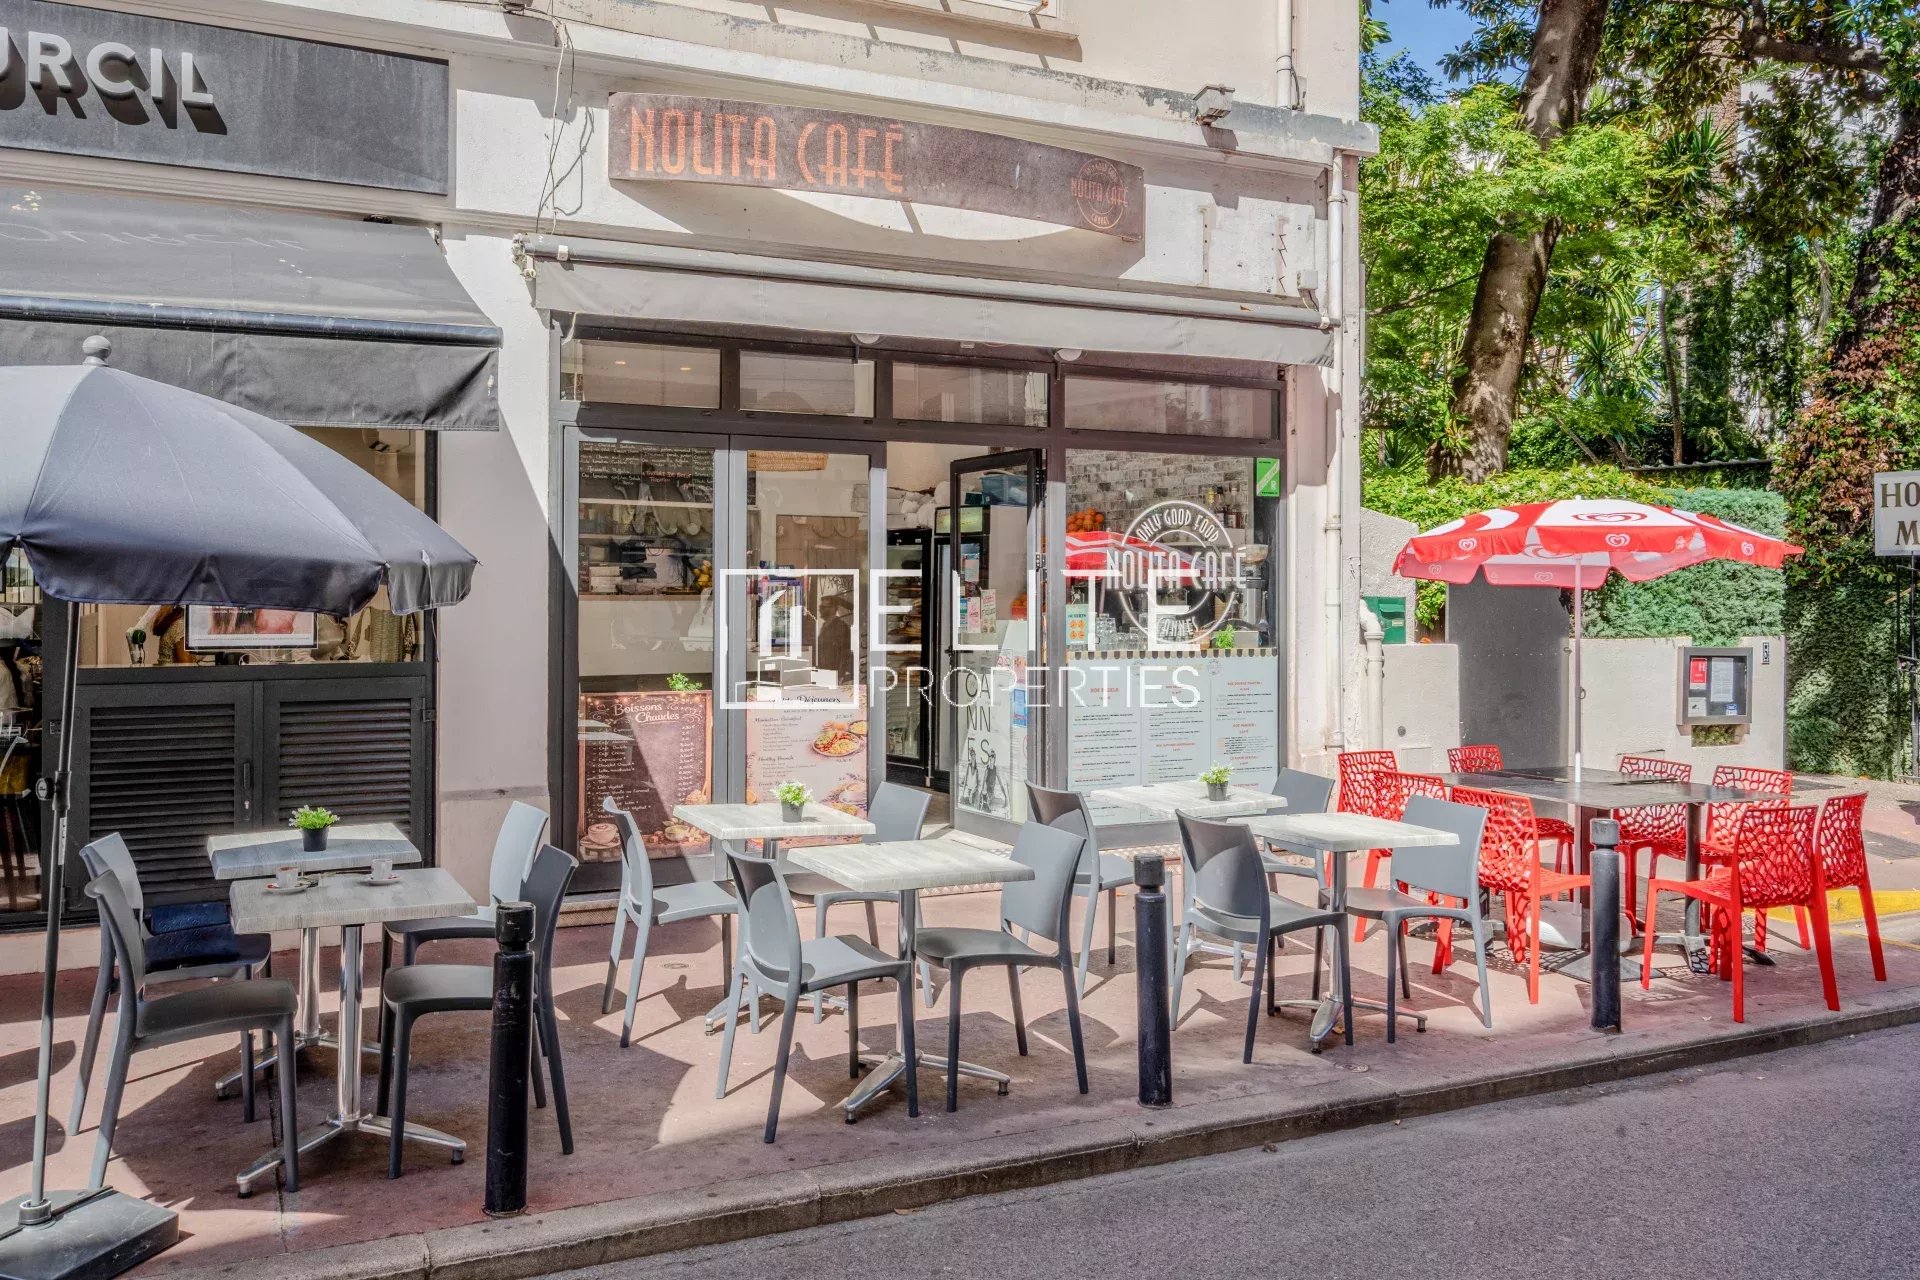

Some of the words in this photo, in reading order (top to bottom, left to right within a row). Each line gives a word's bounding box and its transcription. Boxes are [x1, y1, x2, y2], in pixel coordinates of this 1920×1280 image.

[0, 27, 213, 104] RCIL
[630, 106, 777, 181] NOLITA
[797, 122, 904, 193] CAFÉ
[1136, 514, 1163, 542] ONLY
[1164, 508, 1192, 526] GOOD
[1194, 514, 1219, 543] FOOD
[1107, 549, 1181, 590] NOLITA
[1157, 616, 1199, 638] CANNES
[613, 703, 663, 716] Boissons
[635, 711, 680, 724] Chaudes
